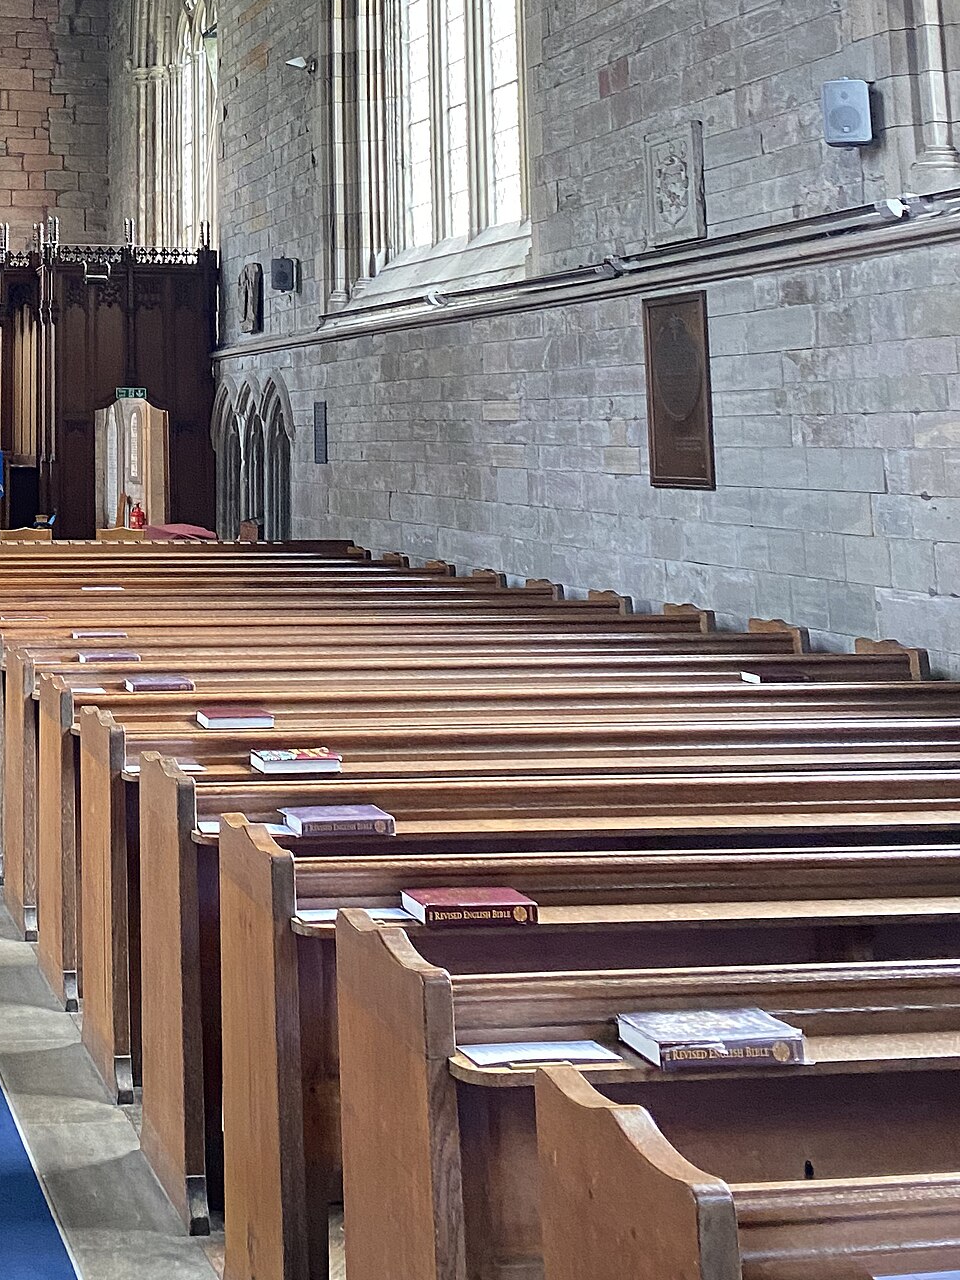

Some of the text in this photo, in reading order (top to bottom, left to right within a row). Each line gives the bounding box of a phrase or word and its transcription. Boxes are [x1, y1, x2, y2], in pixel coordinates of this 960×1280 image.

[434, 911, 462, 920] REVISED
[463, 910, 491, 919] ENGLISH
[492, 909, 511, 918] BIBLE
[672, 1048, 707, 1060] REVISED
[745, 1046, 770, 1058] BIBLE
